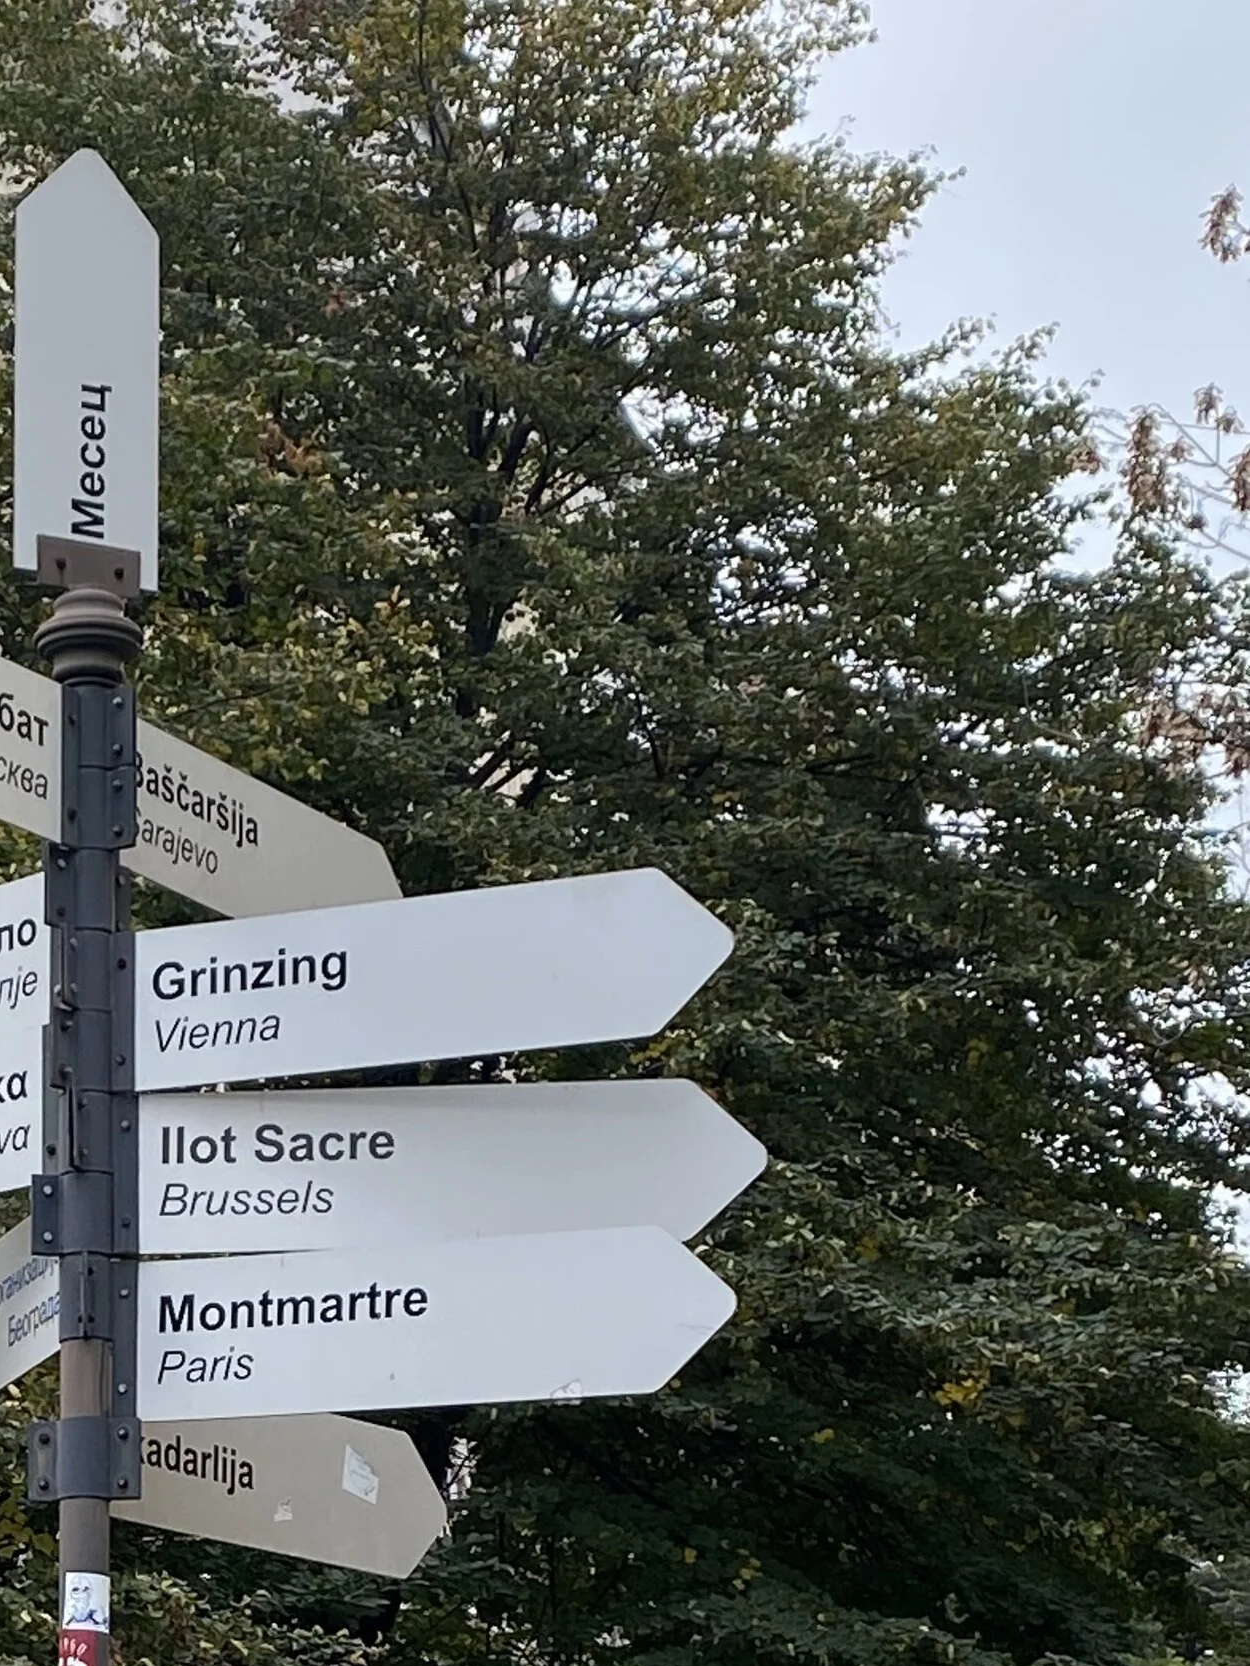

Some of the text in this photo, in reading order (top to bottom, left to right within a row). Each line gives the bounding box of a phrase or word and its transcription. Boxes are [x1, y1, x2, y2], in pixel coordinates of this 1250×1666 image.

[70, 384, 113, 540] Месец
[152, 947, 348, 1001] Grinzing
[155, 1012, 280, 1053] Vienna
[161, 1123, 395, 1165] Ilot Sacre
[158, 1180, 334, 1217] Brussels
[158, 1282, 428, 1334] Montmartre
[157, 1346, 254, 1385] Paris
[140, 1435, 255, 1495] adarlija
